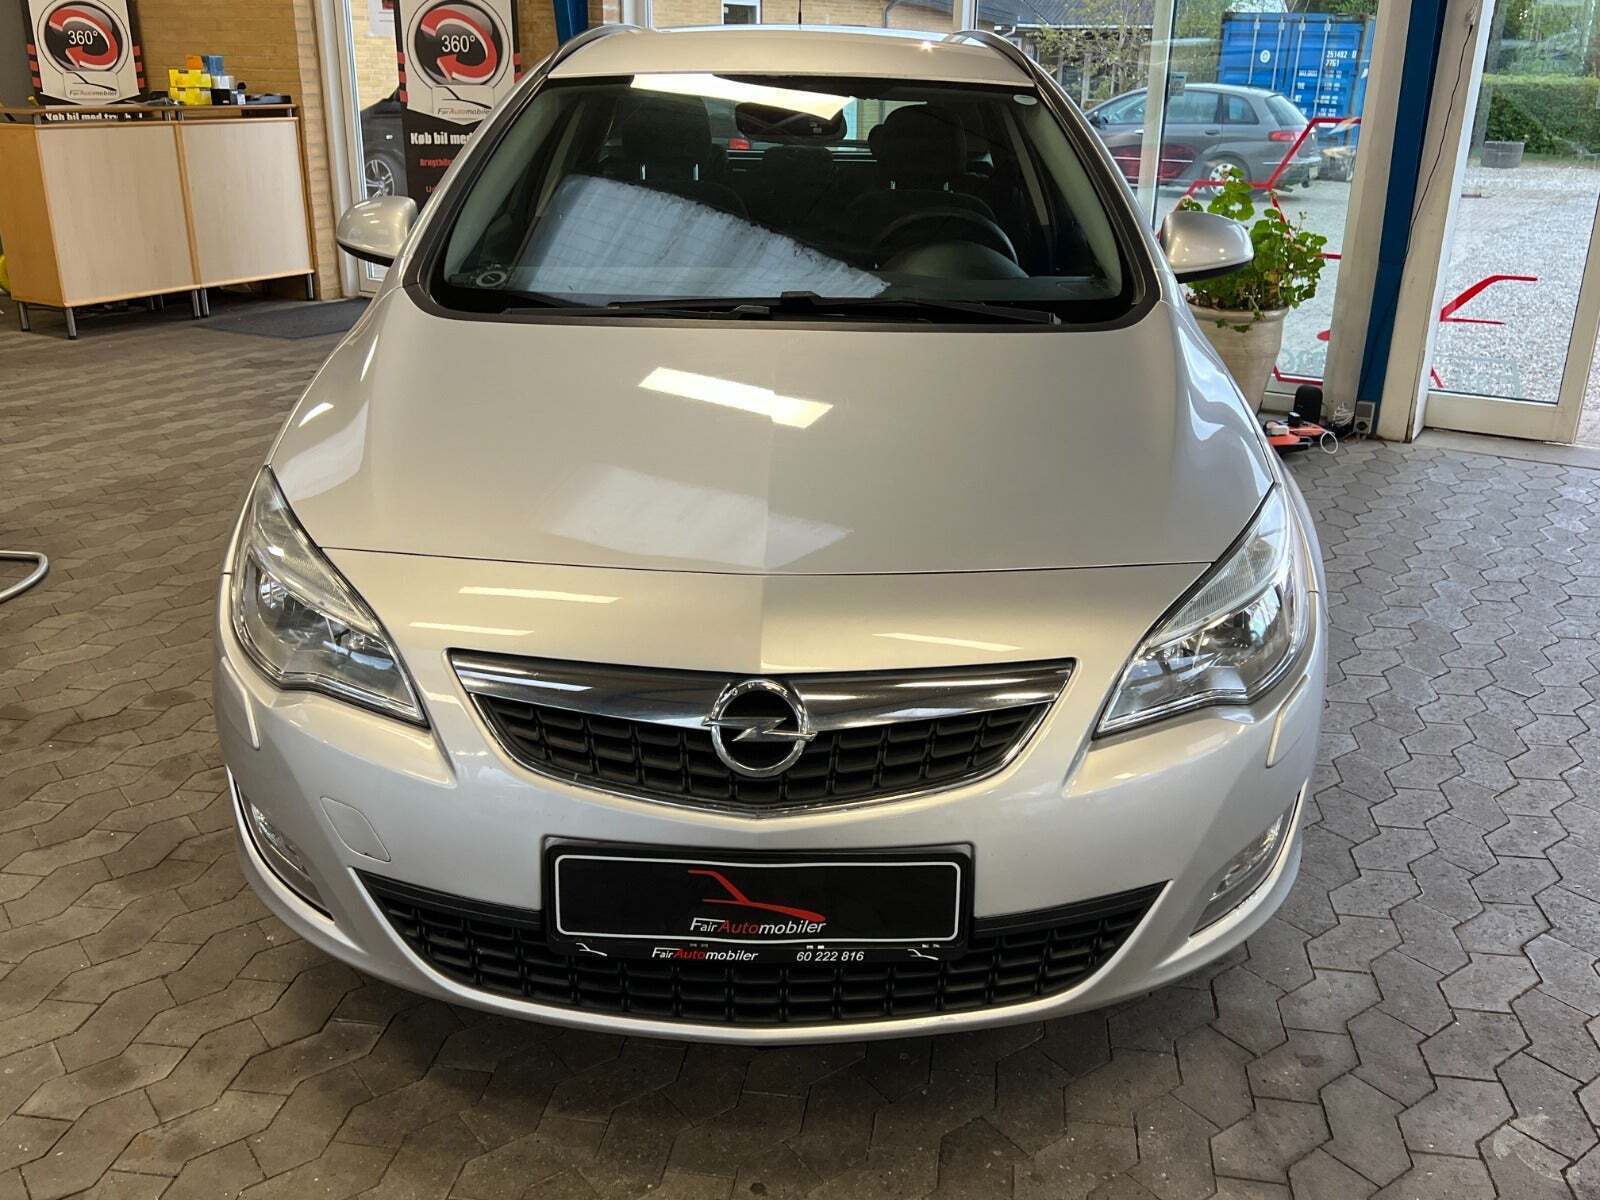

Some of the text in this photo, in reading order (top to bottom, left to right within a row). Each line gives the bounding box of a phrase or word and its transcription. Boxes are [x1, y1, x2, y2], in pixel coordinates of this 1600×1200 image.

[67, 30, 98, 45] 360°
[441, 35, 476, 52] 360°
[410, 132, 432, 145] Køb
[433, 131, 448, 145] bil
[690, 917, 827, 934] FairAutomobiler
[651, 946, 865, 961] FairAutomobiler 60 222 816
